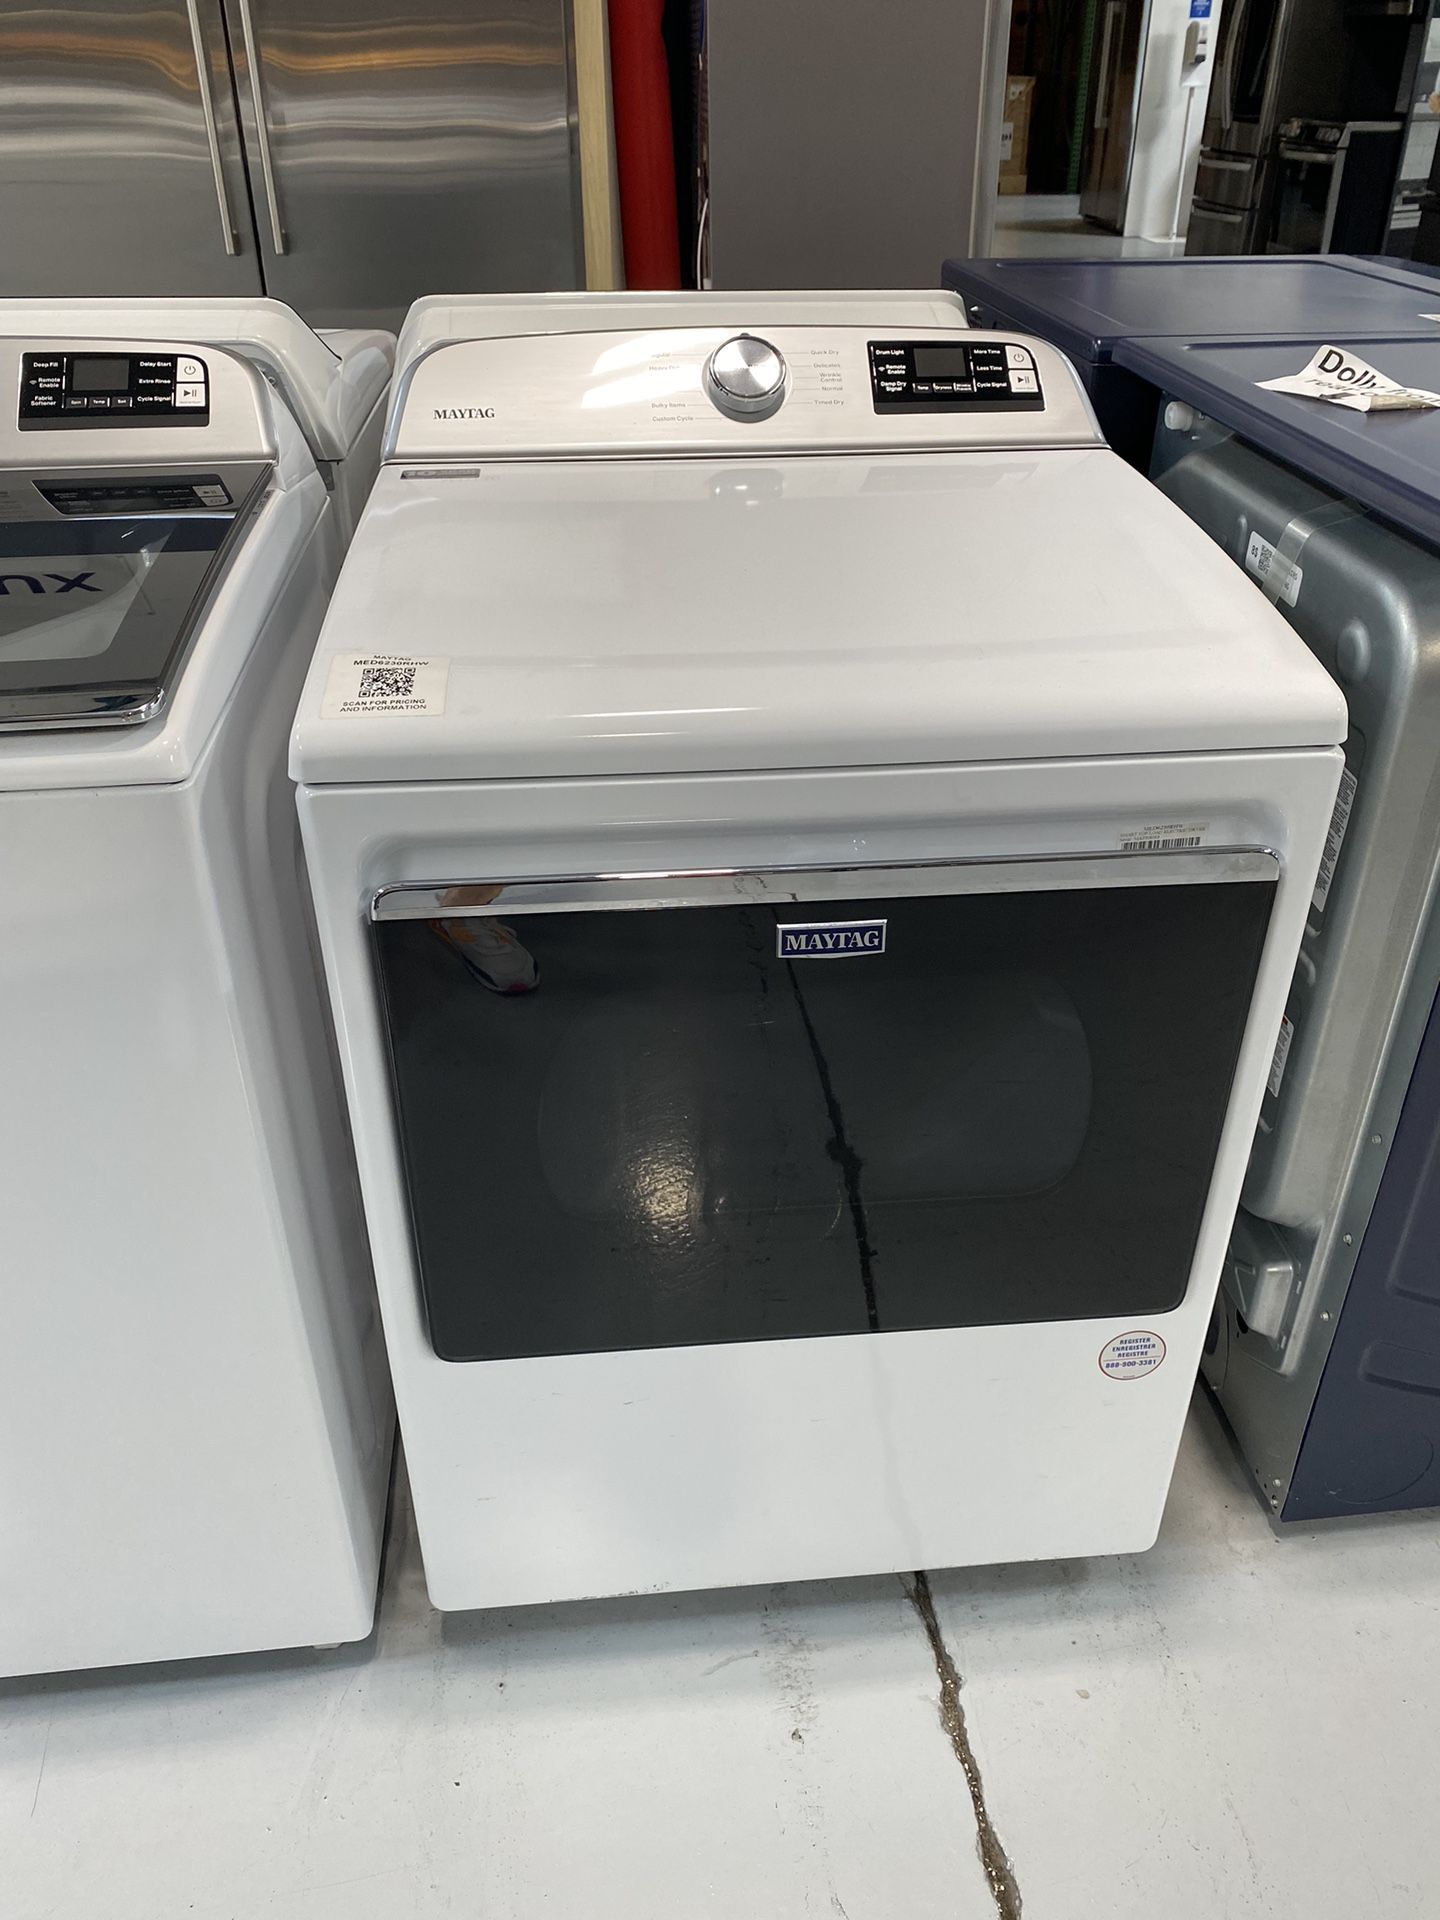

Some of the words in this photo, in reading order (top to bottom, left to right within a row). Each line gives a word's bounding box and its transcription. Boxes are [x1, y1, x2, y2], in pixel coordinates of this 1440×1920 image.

[433, 408, 495, 419] MAYTAG
[361, 704, 427, 712] INFORMATION
[785, 930, 880, 951] MAYTAG
[1120, 1337, 1151, 1345] REGISTER
[1112, 1343, 1156, 1352] ENREGISTRER
